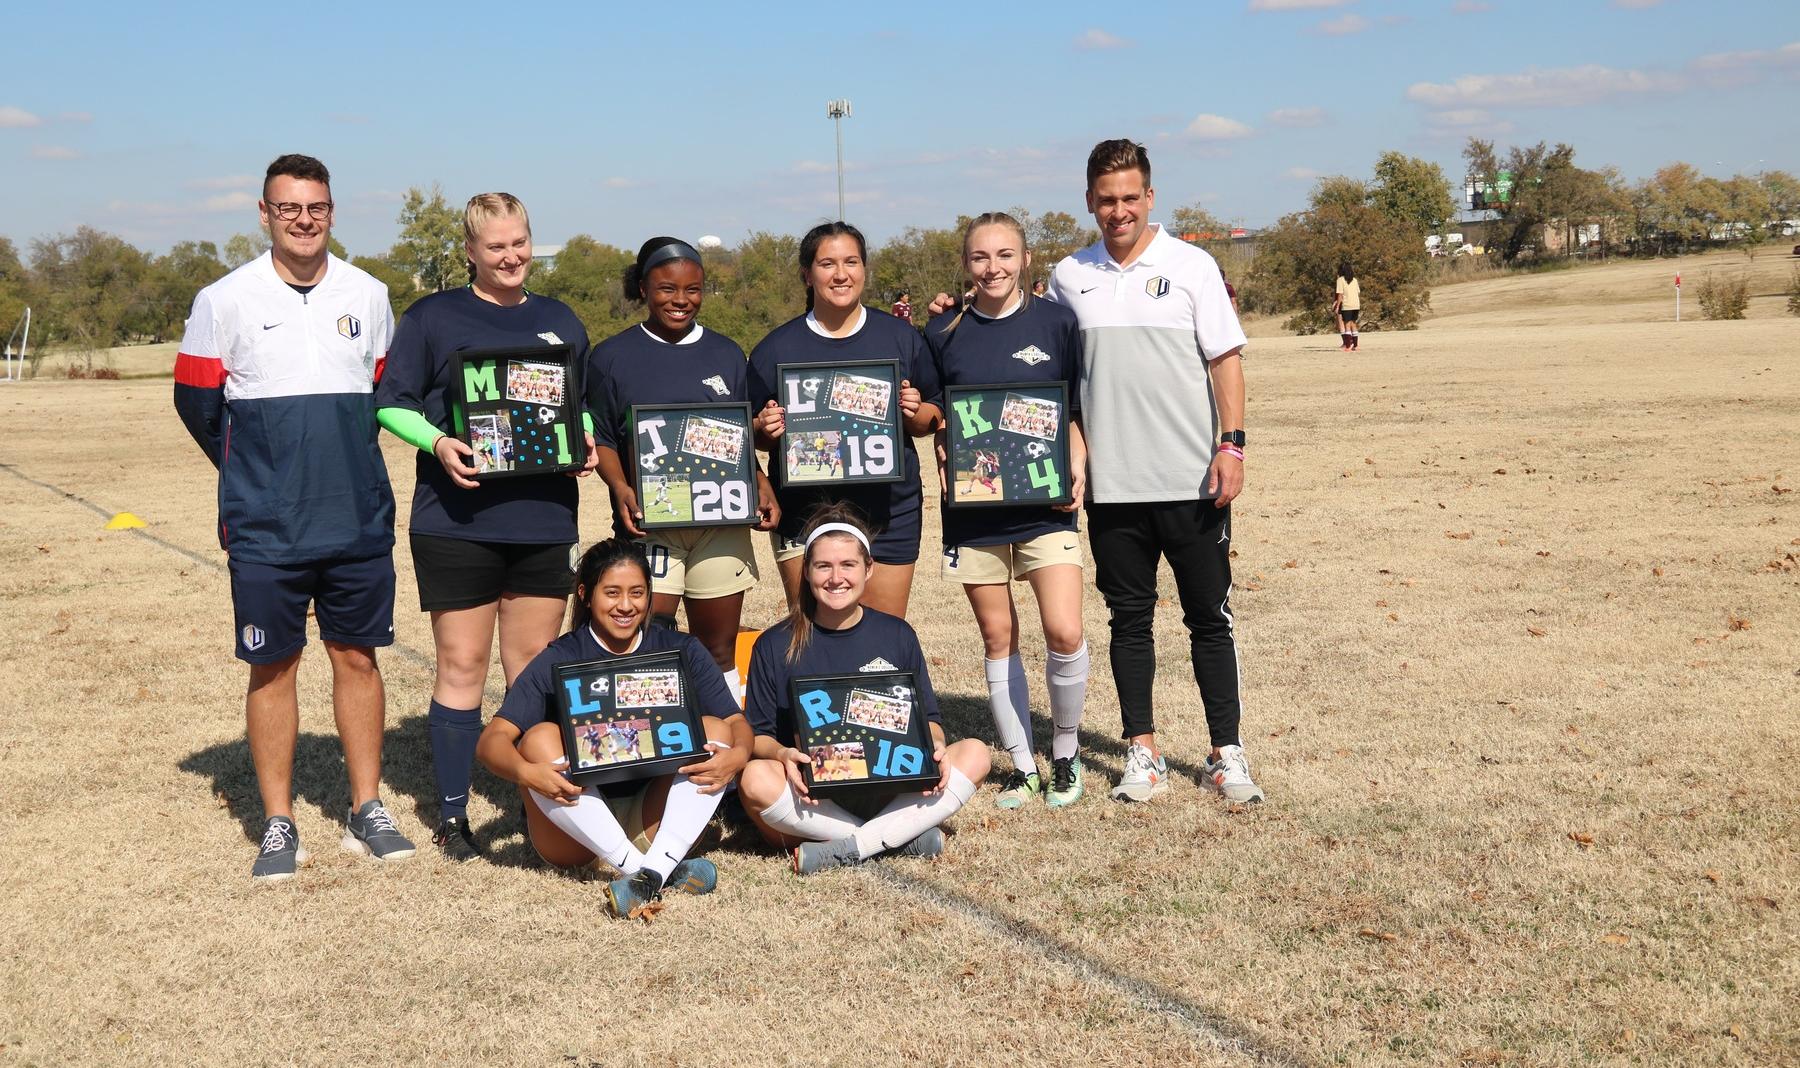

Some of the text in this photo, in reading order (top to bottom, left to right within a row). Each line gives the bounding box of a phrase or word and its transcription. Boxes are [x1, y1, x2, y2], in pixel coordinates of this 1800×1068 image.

[463, 360, 501, 402] M
[785, 374, 815, 414] L
[638, 416, 669, 457] T
[952, 394, 993, 439] K
[554, 423, 573, 465] 1
[847, 434, 894, 476] 19
[1027, 458, 1060, 499] 4
[692, 480, 750, 520] 20
[564, 678, 601, 716] L
[799, 689, 841, 729] R
[657, 722, 694, 756] 9
[872, 738, 925, 777] 10
